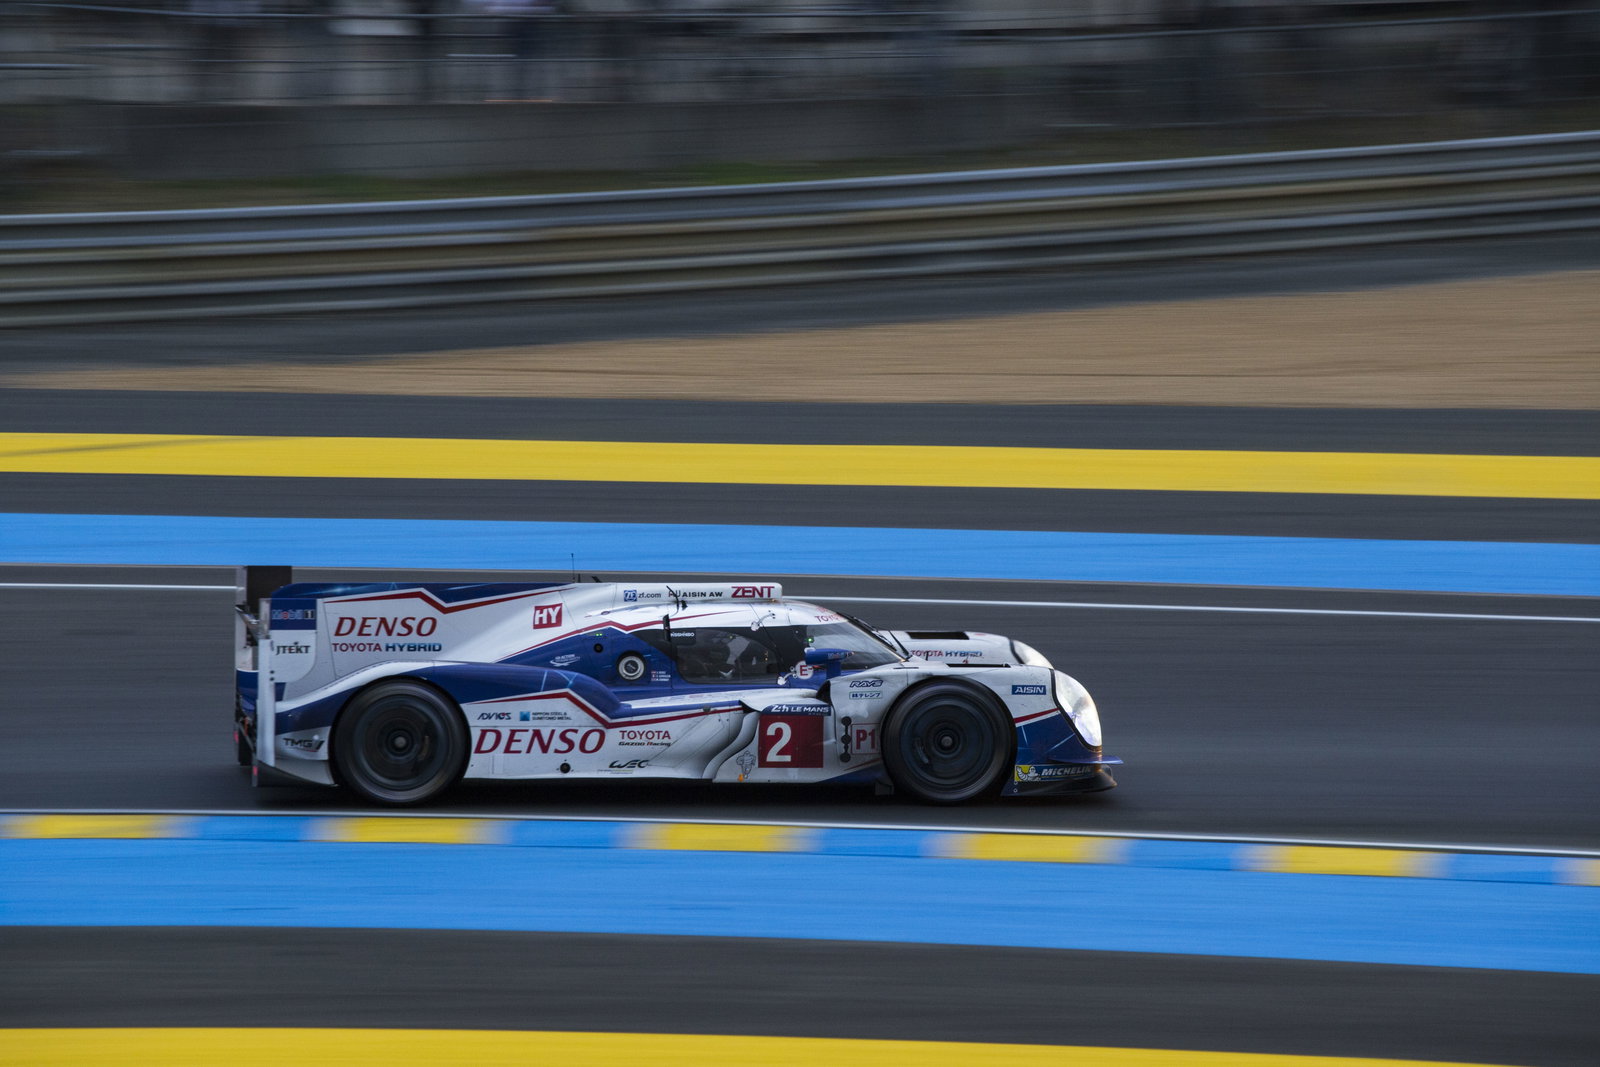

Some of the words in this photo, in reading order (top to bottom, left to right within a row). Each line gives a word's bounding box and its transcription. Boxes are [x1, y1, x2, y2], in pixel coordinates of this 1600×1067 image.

[731, 586, 775, 598] ZENT
[534, 606, 561, 625] HY
[334, 616, 438, 637] DENSO
[275, 643, 311, 656] JTEKT
[332, 643, 382, 652] TOYOTA
[385, 643, 442, 652] HYBRID
[1014, 686, 1045, 694] AISIN
[473, 728, 606, 754] DENSO
[619, 730, 671, 740] TOYOTA
[855, 729, 876, 750] P1
[766, 721, 792, 762] 2
[608, 760, 650, 769] WEC
[1041, 766, 1092, 776] MICHELIN
